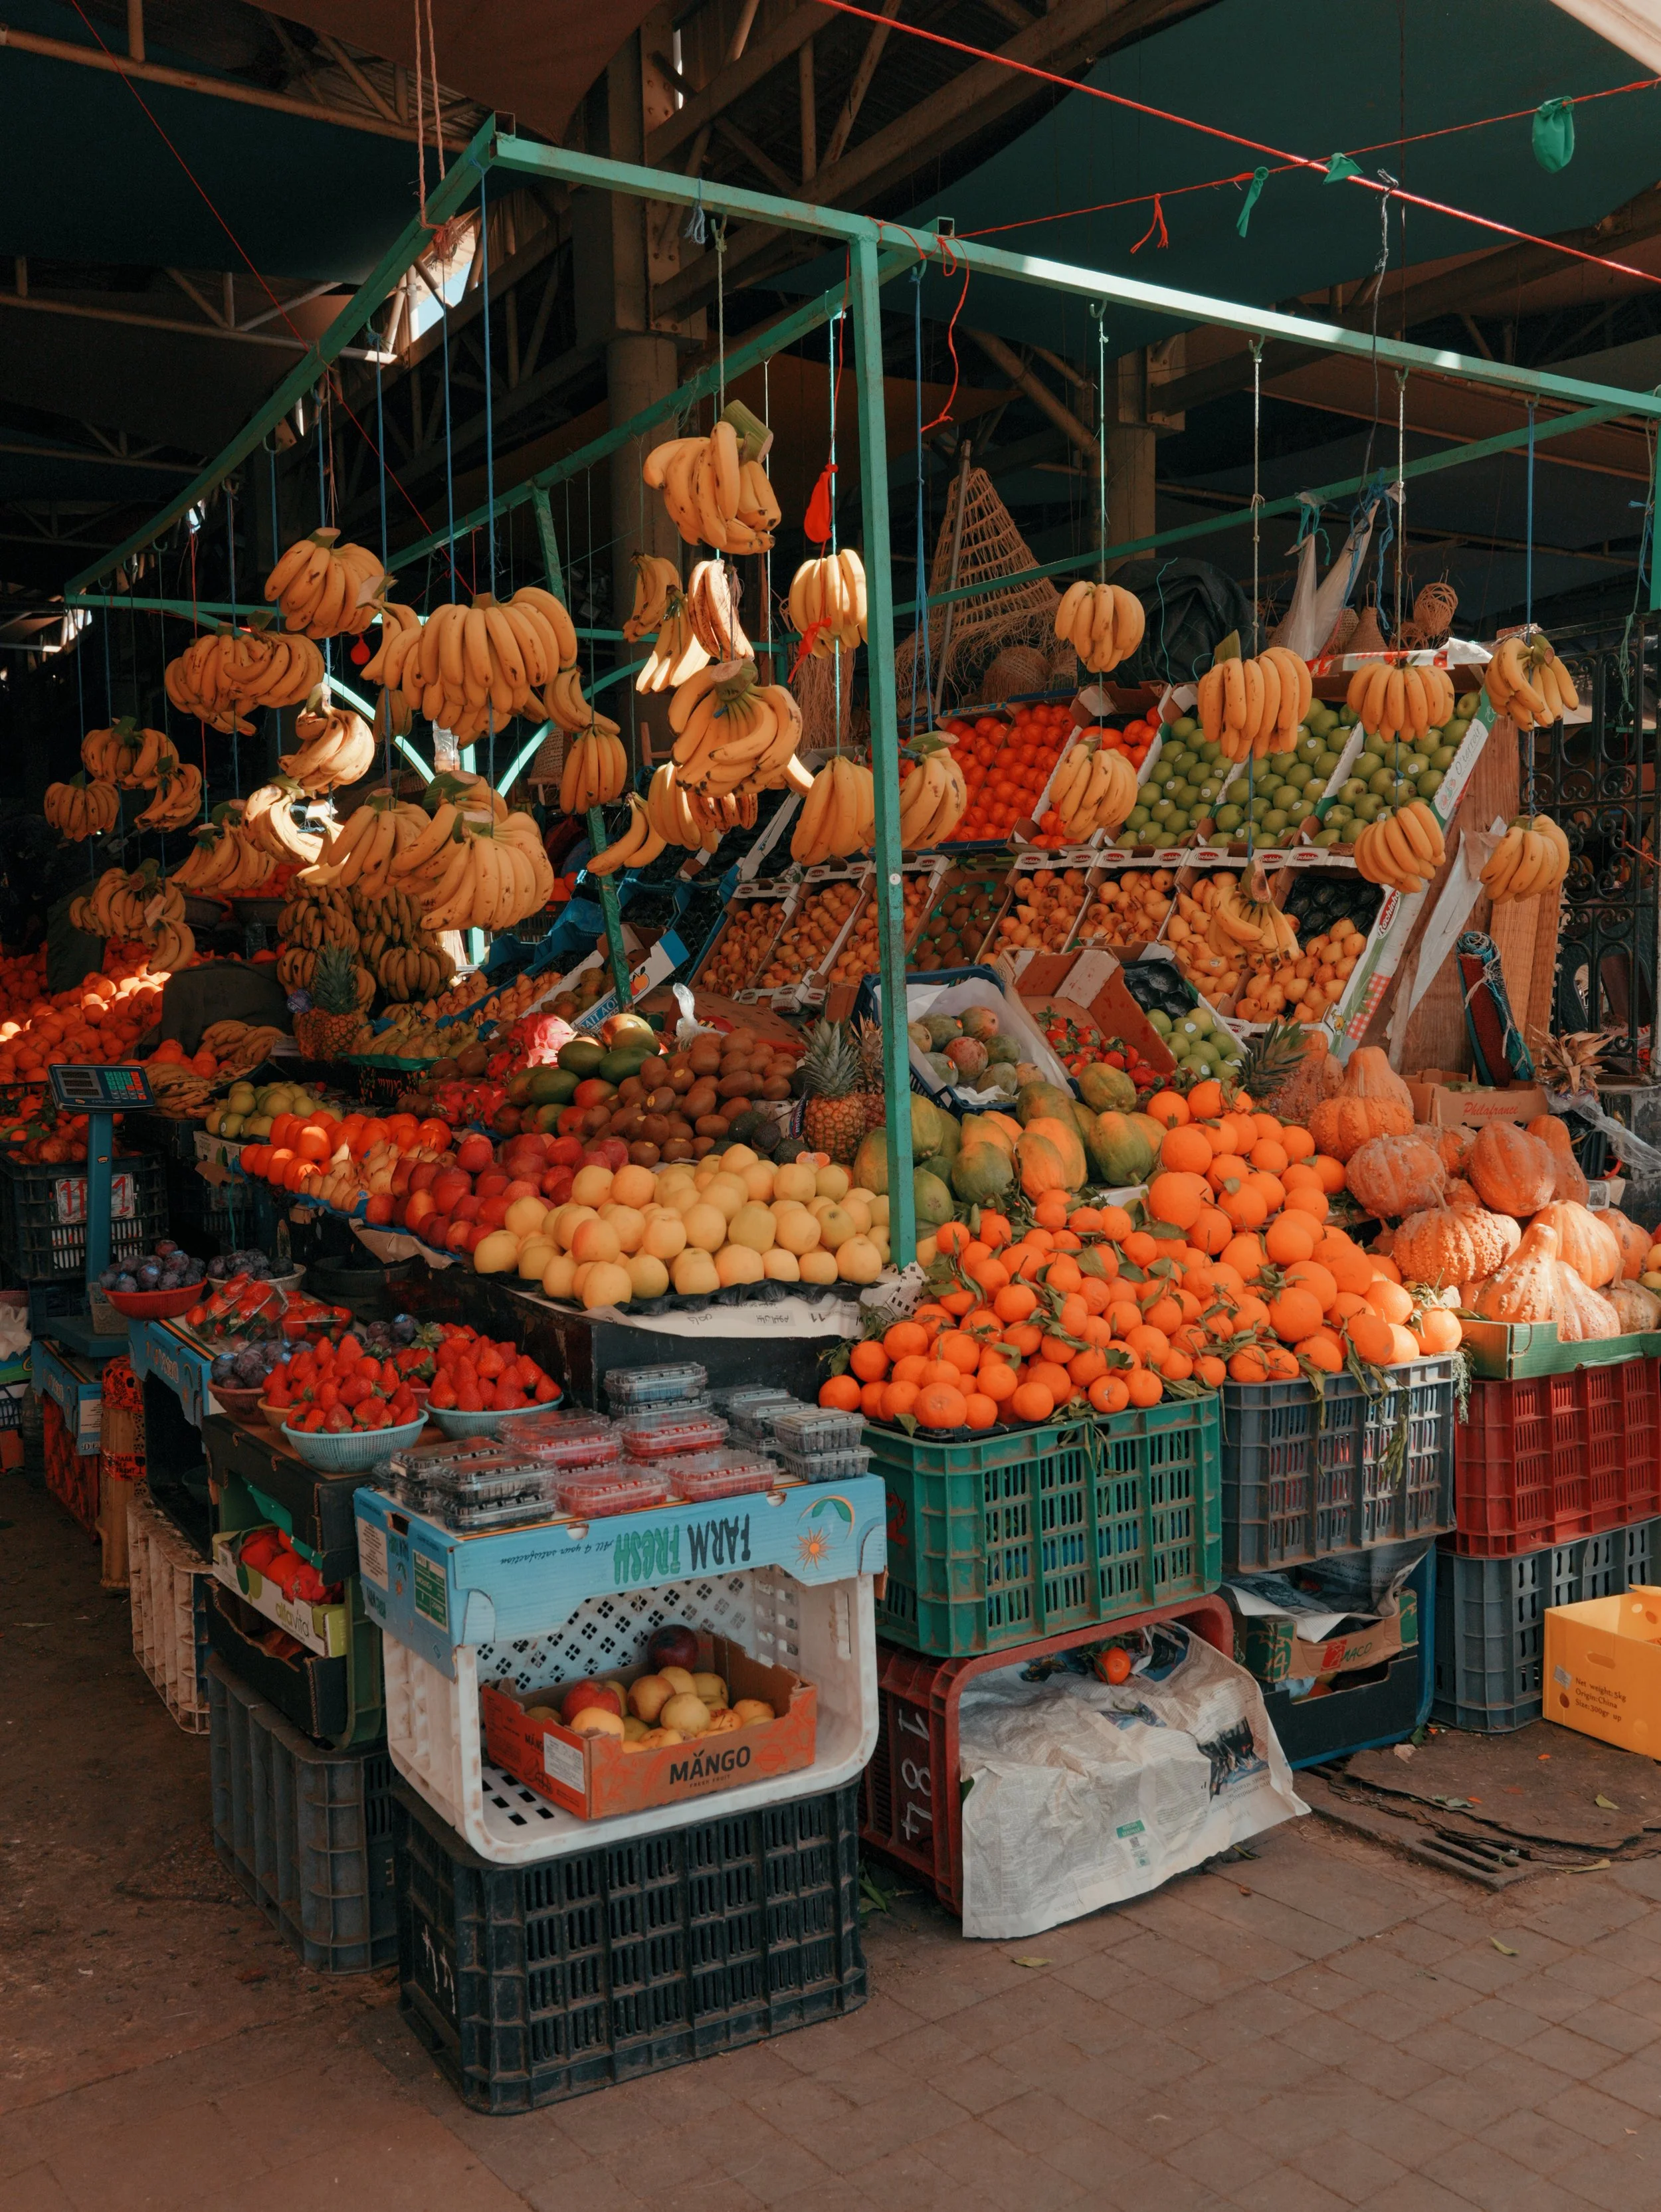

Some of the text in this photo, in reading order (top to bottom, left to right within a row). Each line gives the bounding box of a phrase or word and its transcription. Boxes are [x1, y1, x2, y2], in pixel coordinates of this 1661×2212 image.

[1377, 890, 1400, 937] Rochinho
[559, 1544, 583, 1556] your
[686, 1513, 752, 1572] FARM
[500, 1548, 558, 1566] satisfaction
[613, 1524, 682, 1585] FRESH
[276, 1602, 310, 1639] alfavita
[1575, 1677, 1587, 1687] Net
[1612, 1714, 1622, 1722] up
[689, 1774, 732, 1788] FRESH FRUIT
